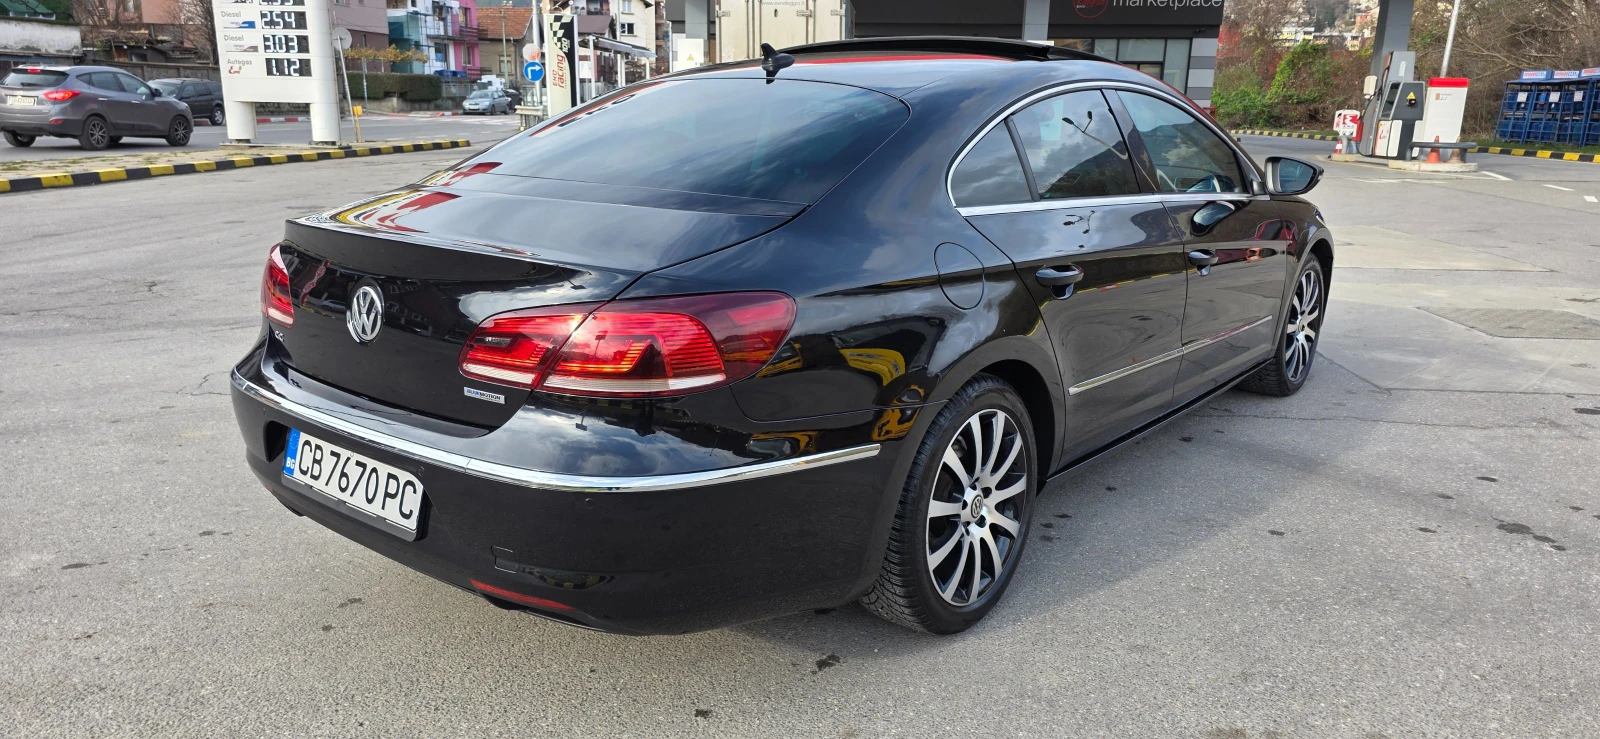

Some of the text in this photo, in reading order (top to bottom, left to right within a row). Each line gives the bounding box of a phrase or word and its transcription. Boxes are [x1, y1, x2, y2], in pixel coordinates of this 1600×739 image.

[261, 11, 295, 29] 2.54
[264, 35, 298, 53] 3.03
[271, 59, 300, 76] 1.12
[557, 54, 565, 88] racing
[285, 457, 295, 469] BG
[298, 439, 417, 520] CB 7670 PC
